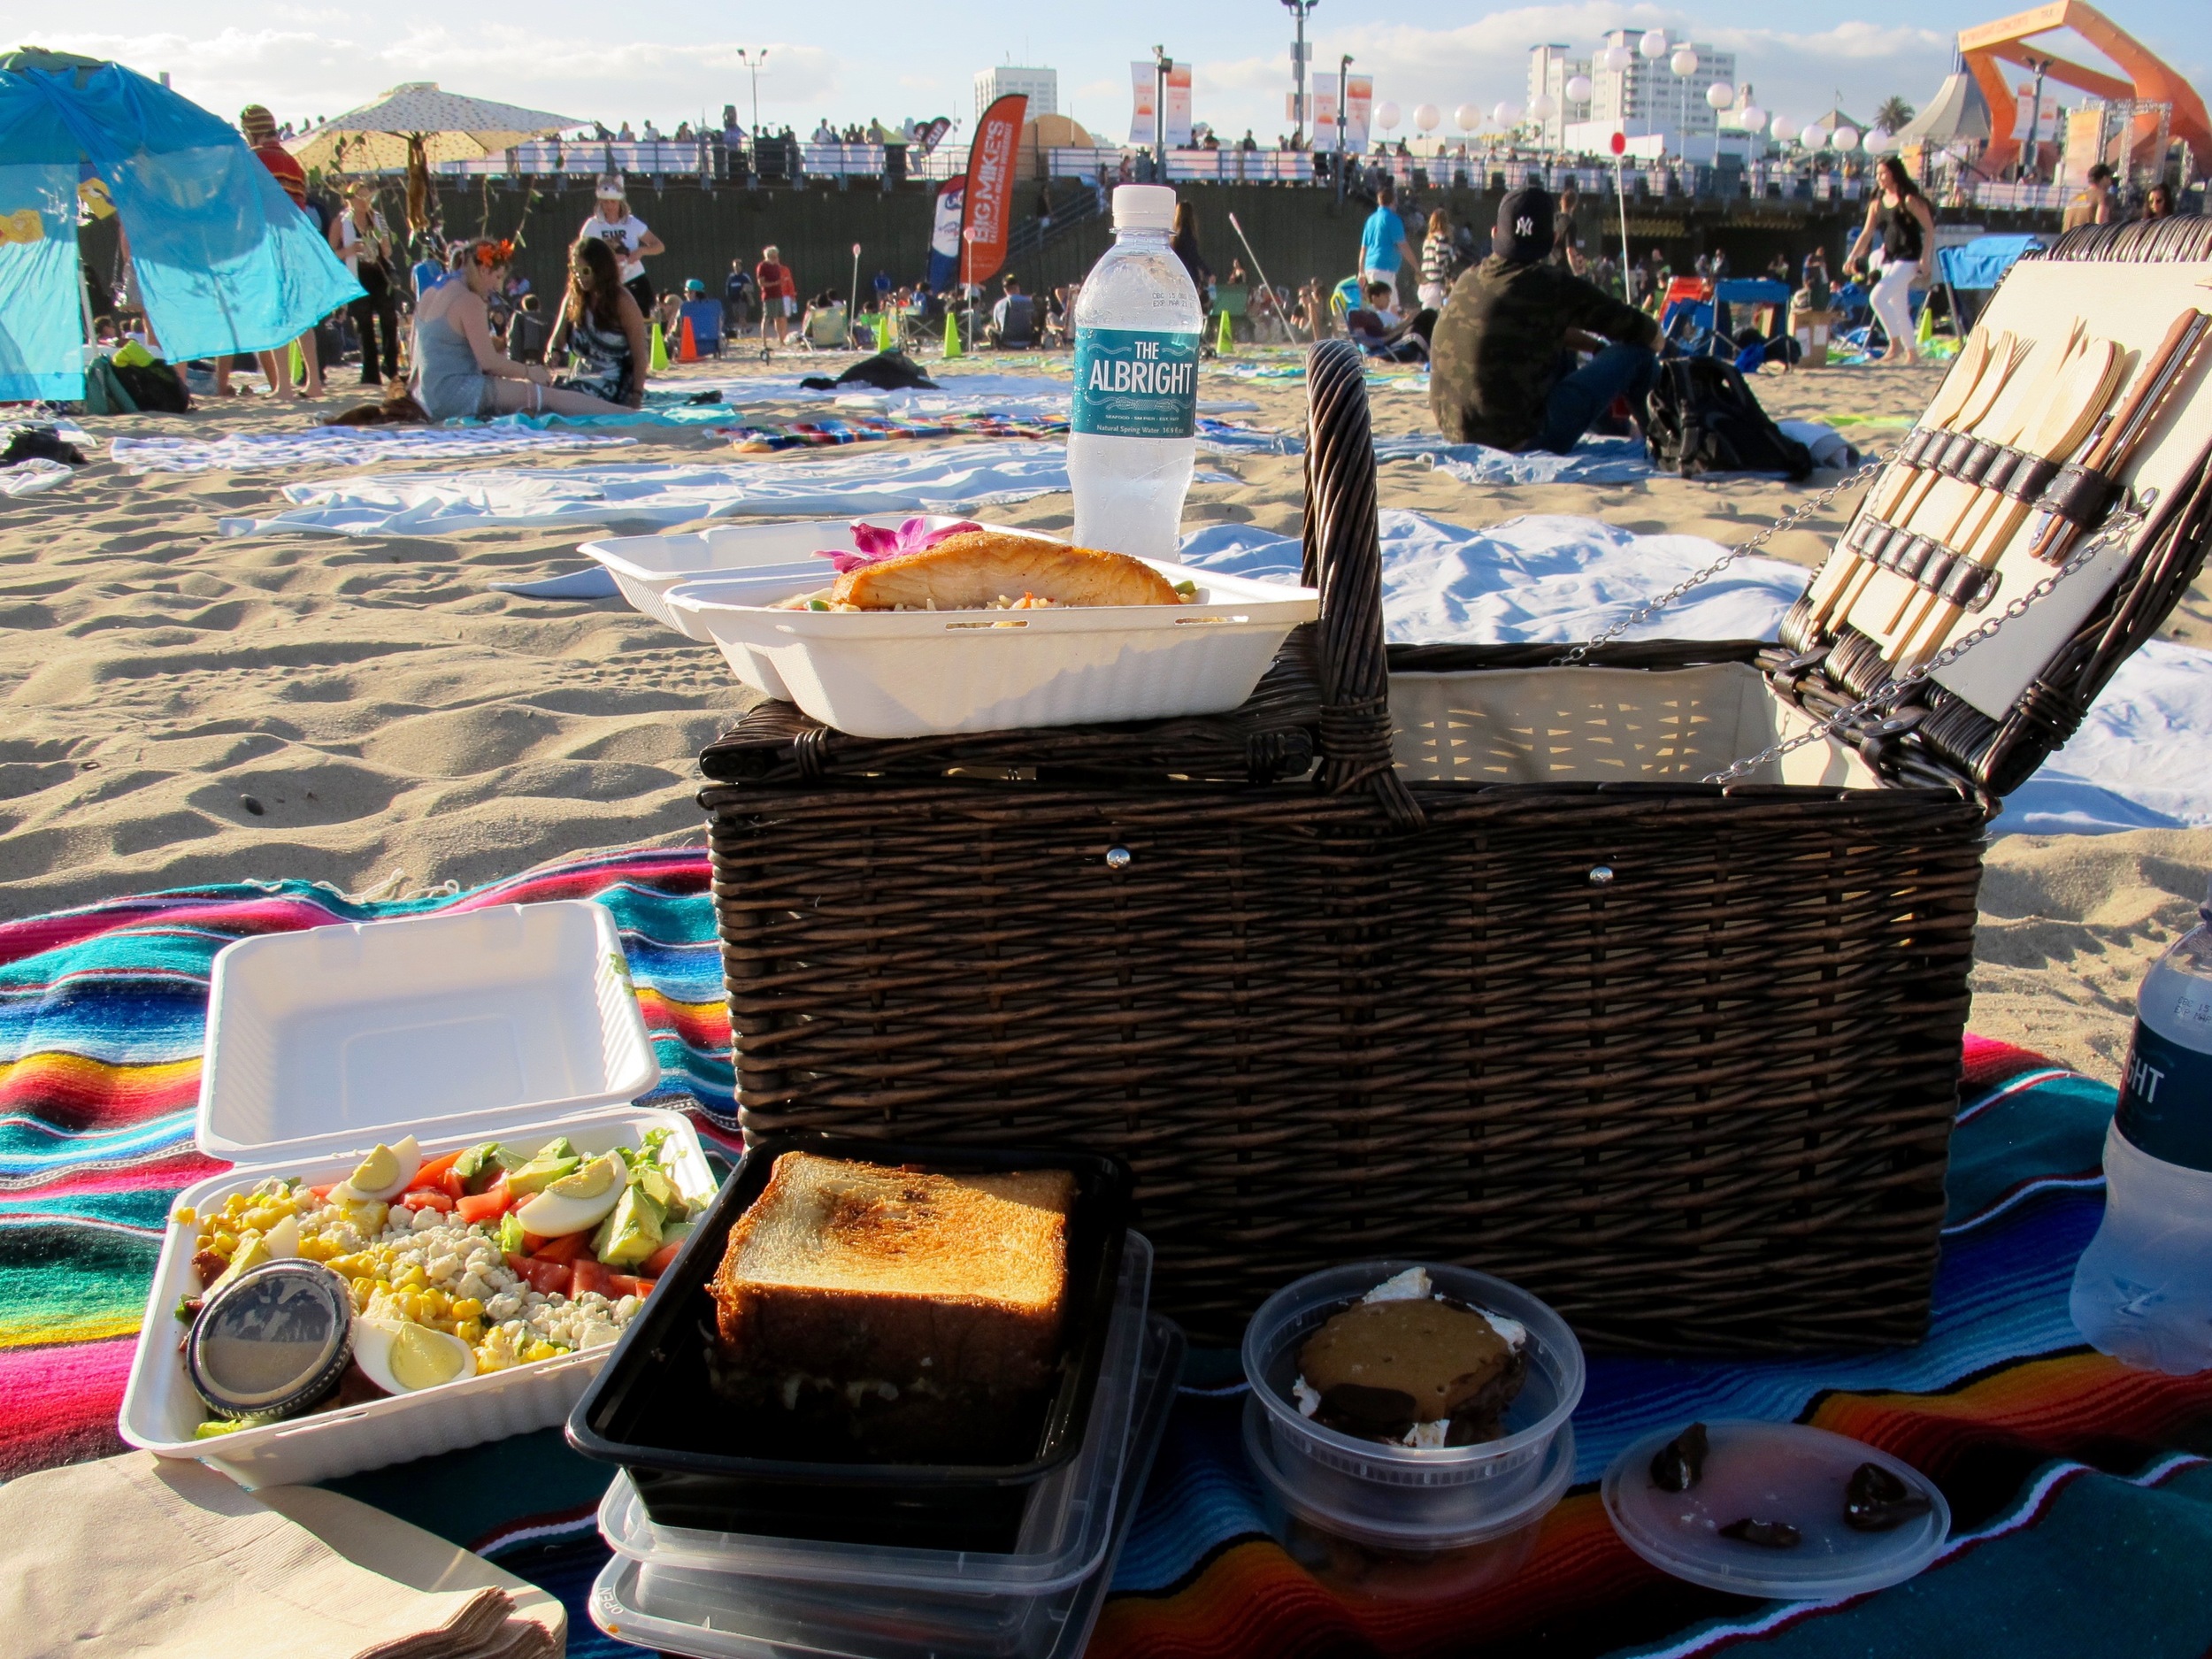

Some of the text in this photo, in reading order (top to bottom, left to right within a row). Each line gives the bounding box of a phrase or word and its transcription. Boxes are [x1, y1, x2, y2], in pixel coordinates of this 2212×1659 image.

[975, 119, 1004, 200] MIKE'S
[972, 203, 991, 242] BIG
[1516, 216, 1533, 236] NY
[1135, 342, 1159, 360] THE
[1088, 359, 1193, 395] ALBRIGHT
[1120, 426, 1141, 434] Spring
[599, 1586, 624, 1615] OPEN
